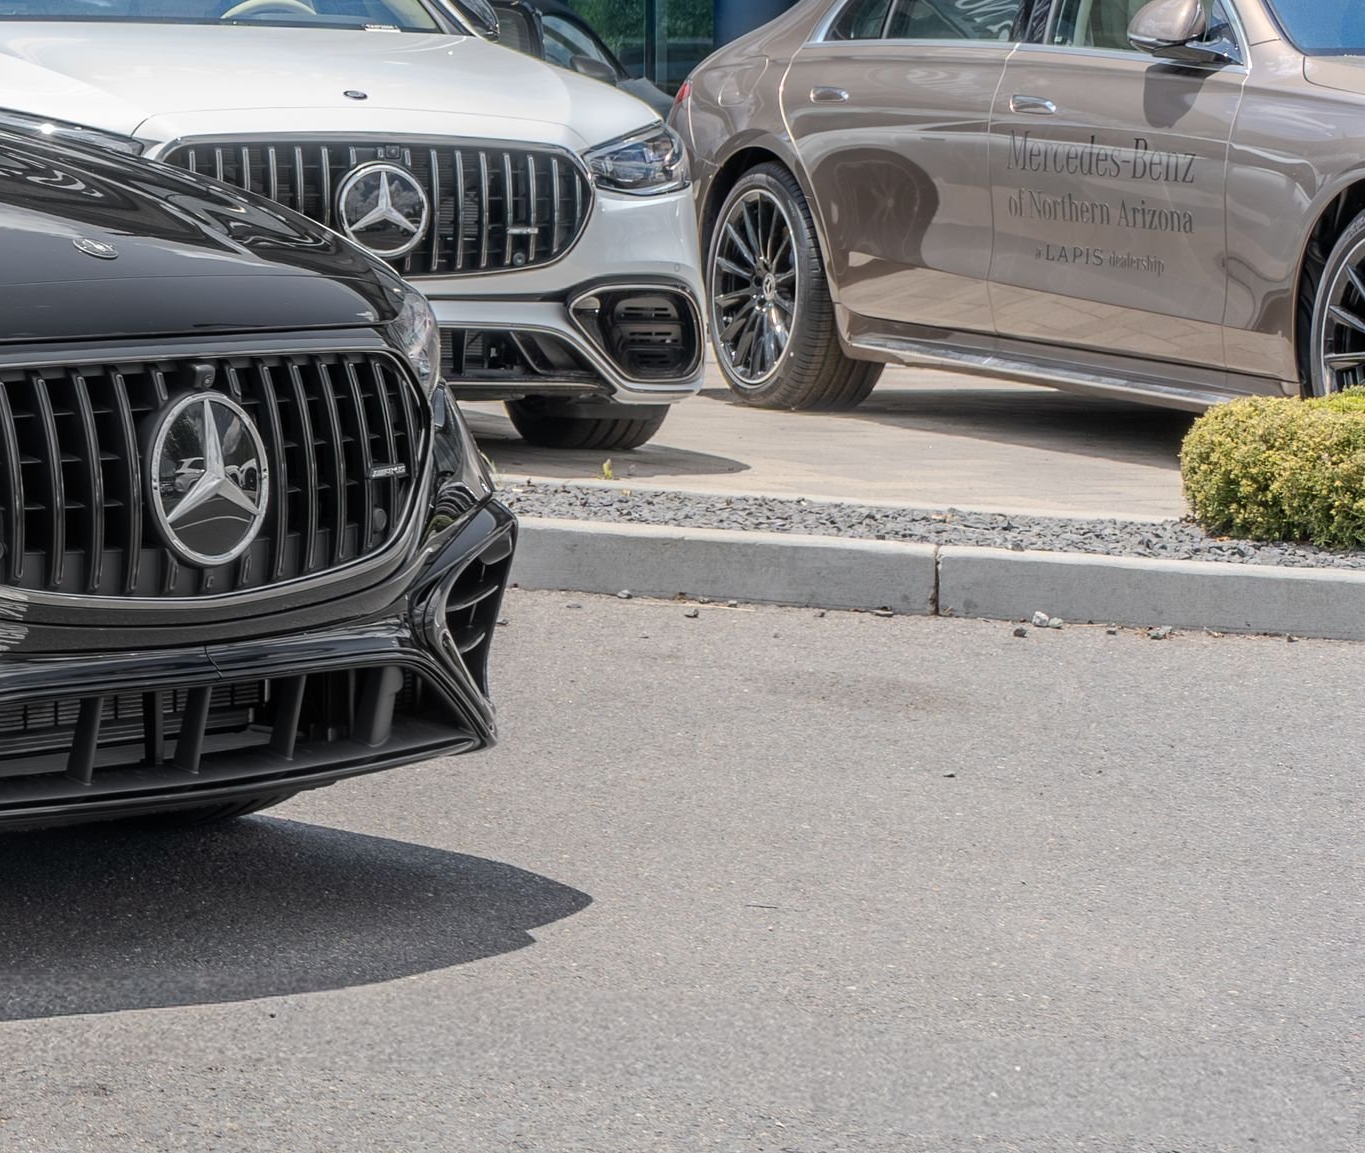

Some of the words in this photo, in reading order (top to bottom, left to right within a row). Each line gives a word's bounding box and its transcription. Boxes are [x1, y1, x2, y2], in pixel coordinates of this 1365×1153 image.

[1007, 130, 1196, 184] Mercedes-Benz
[1008, 188, 1025, 217] of
[1029, 190, 1110, 225] Northern
[1117, 200, 1194, 233] Arizona
[1045, 244, 1104, 266] LAPIS
[1109, 249, 1165, 277] dealership
